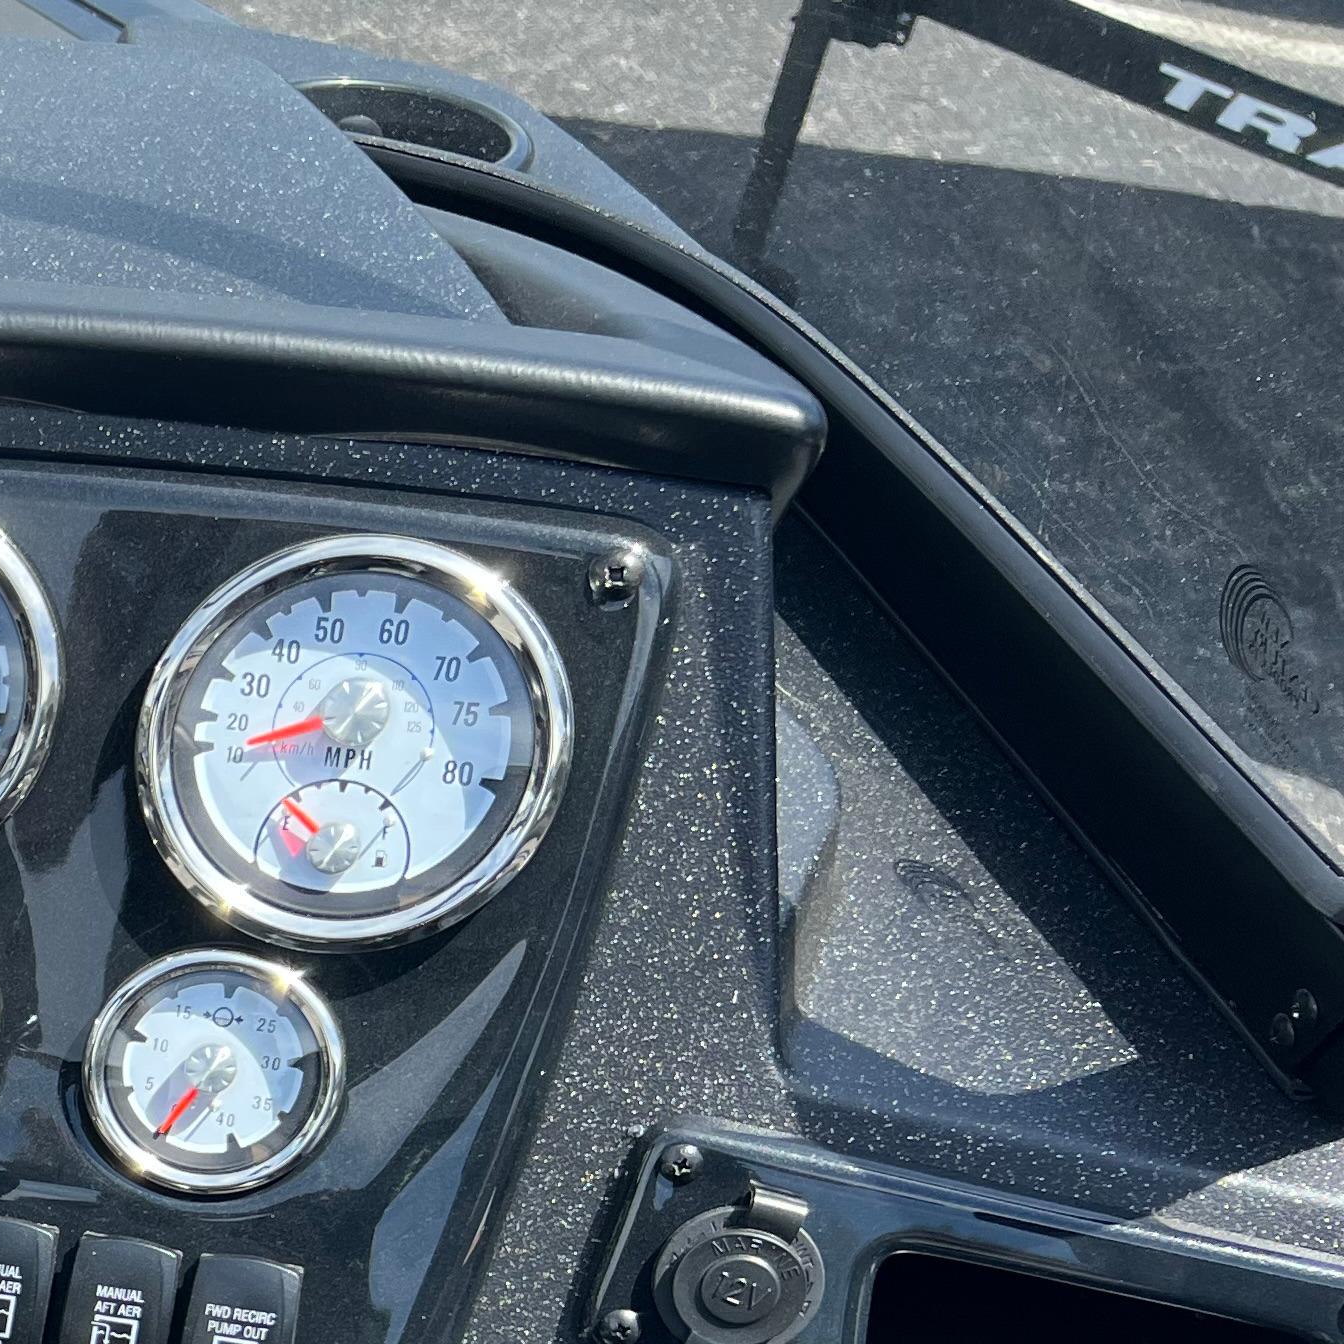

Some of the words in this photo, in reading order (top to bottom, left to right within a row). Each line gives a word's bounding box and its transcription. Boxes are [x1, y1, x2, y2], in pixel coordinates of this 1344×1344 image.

[315, 616, 344, 644] 50
[379, 618, 409, 645] 60
[271, 639, 300, 664] 40
[433, 656, 461, 682] 70
[241, 672, 270, 698] 30
[309, 680, 321, 690] 60
[404, 702, 418, 713] 120
[452, 701, 480, 727] 75
[226, 713, 248, 731] 20
[226, 746, 243, 763] 10
[324, 747, 372, 770] MPH
[443, 760, 473, 786] 80
[283, 815, 290, 831] E
[383, 825, 390, 840] F
[176, 1005, 192, 1020] 15
[256, 1018, 276, 1033] 25
[153, 1038, 168, 1052] 10
[261, 1056, 280, 1070] 30
[145, 1077, 154, 1090] 5
[252, 1096, 272, 1112] 35
[216, 1112, 235, 1126] 40
[96, 1284, 144, 1303] MANUAL
[94, 1301, 116, 1314] AFT
[117, 1305, 142, 1319] AER
[205, 1304, 231, 1319] FWD
[233, 1308, 278, 1326] RECIRC
[207, 1320, 241, 1336] PUMP
[243, 1326, 269, 1341] OUT
